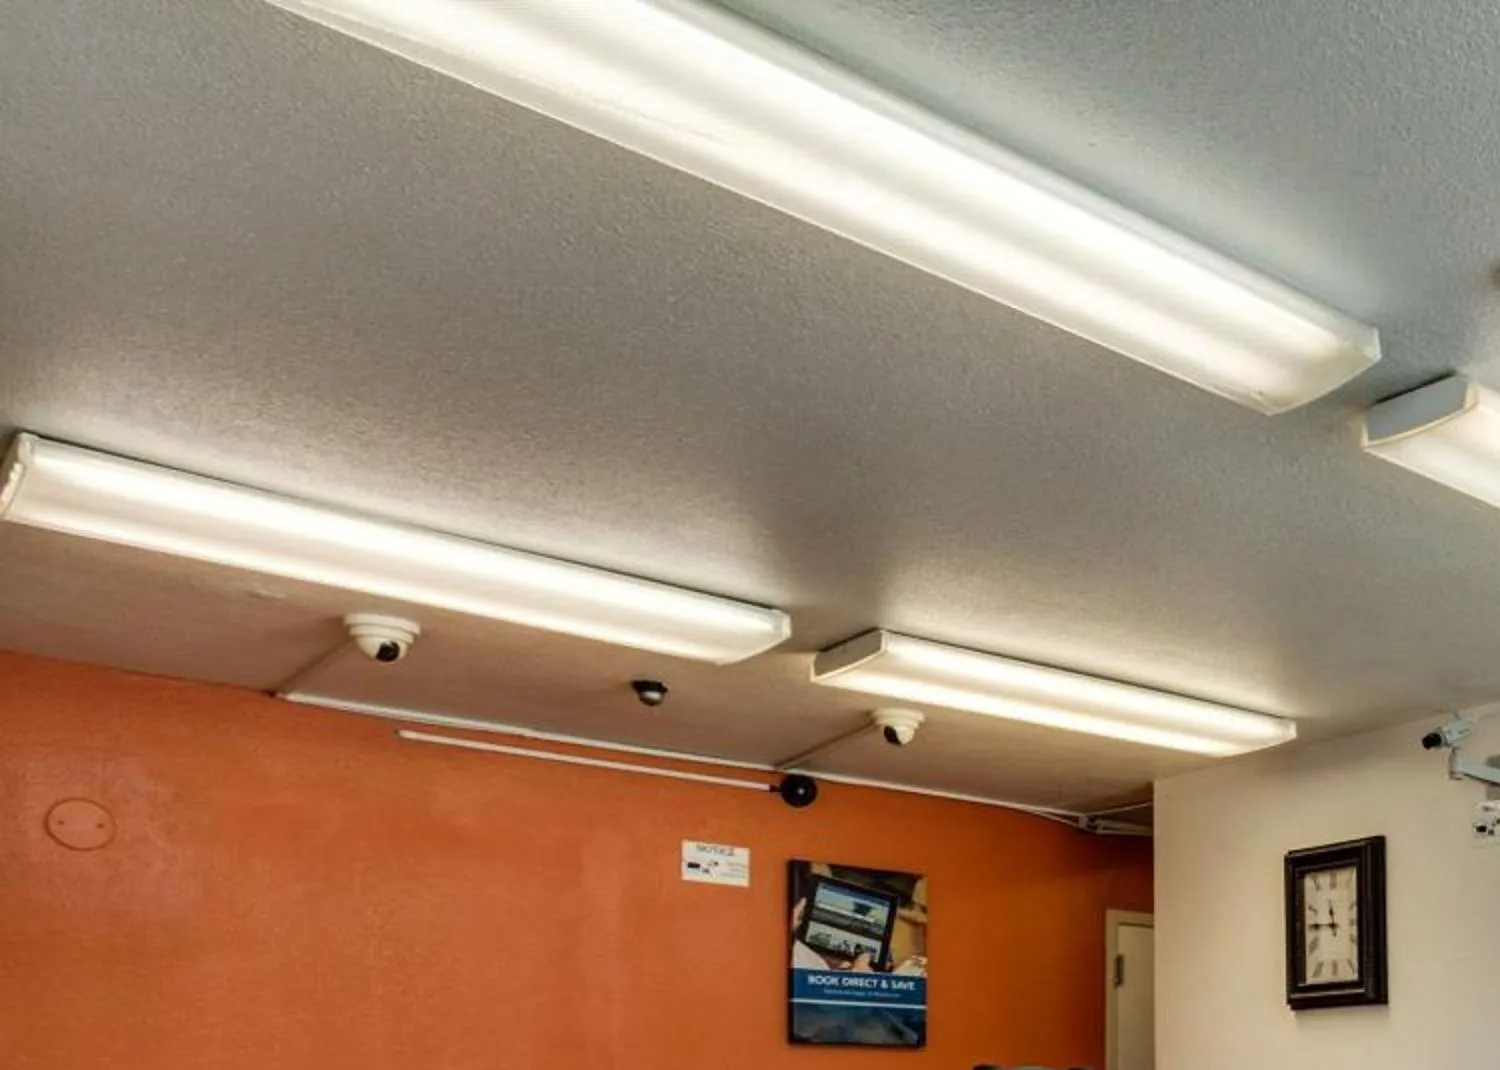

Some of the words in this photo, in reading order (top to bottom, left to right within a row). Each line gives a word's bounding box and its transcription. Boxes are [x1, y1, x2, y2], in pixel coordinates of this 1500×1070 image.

[807, 974, 838, 985] BOOK
[842, 977, 877, 988] DIRECT
[892, 980, 916, 990] SAVE
